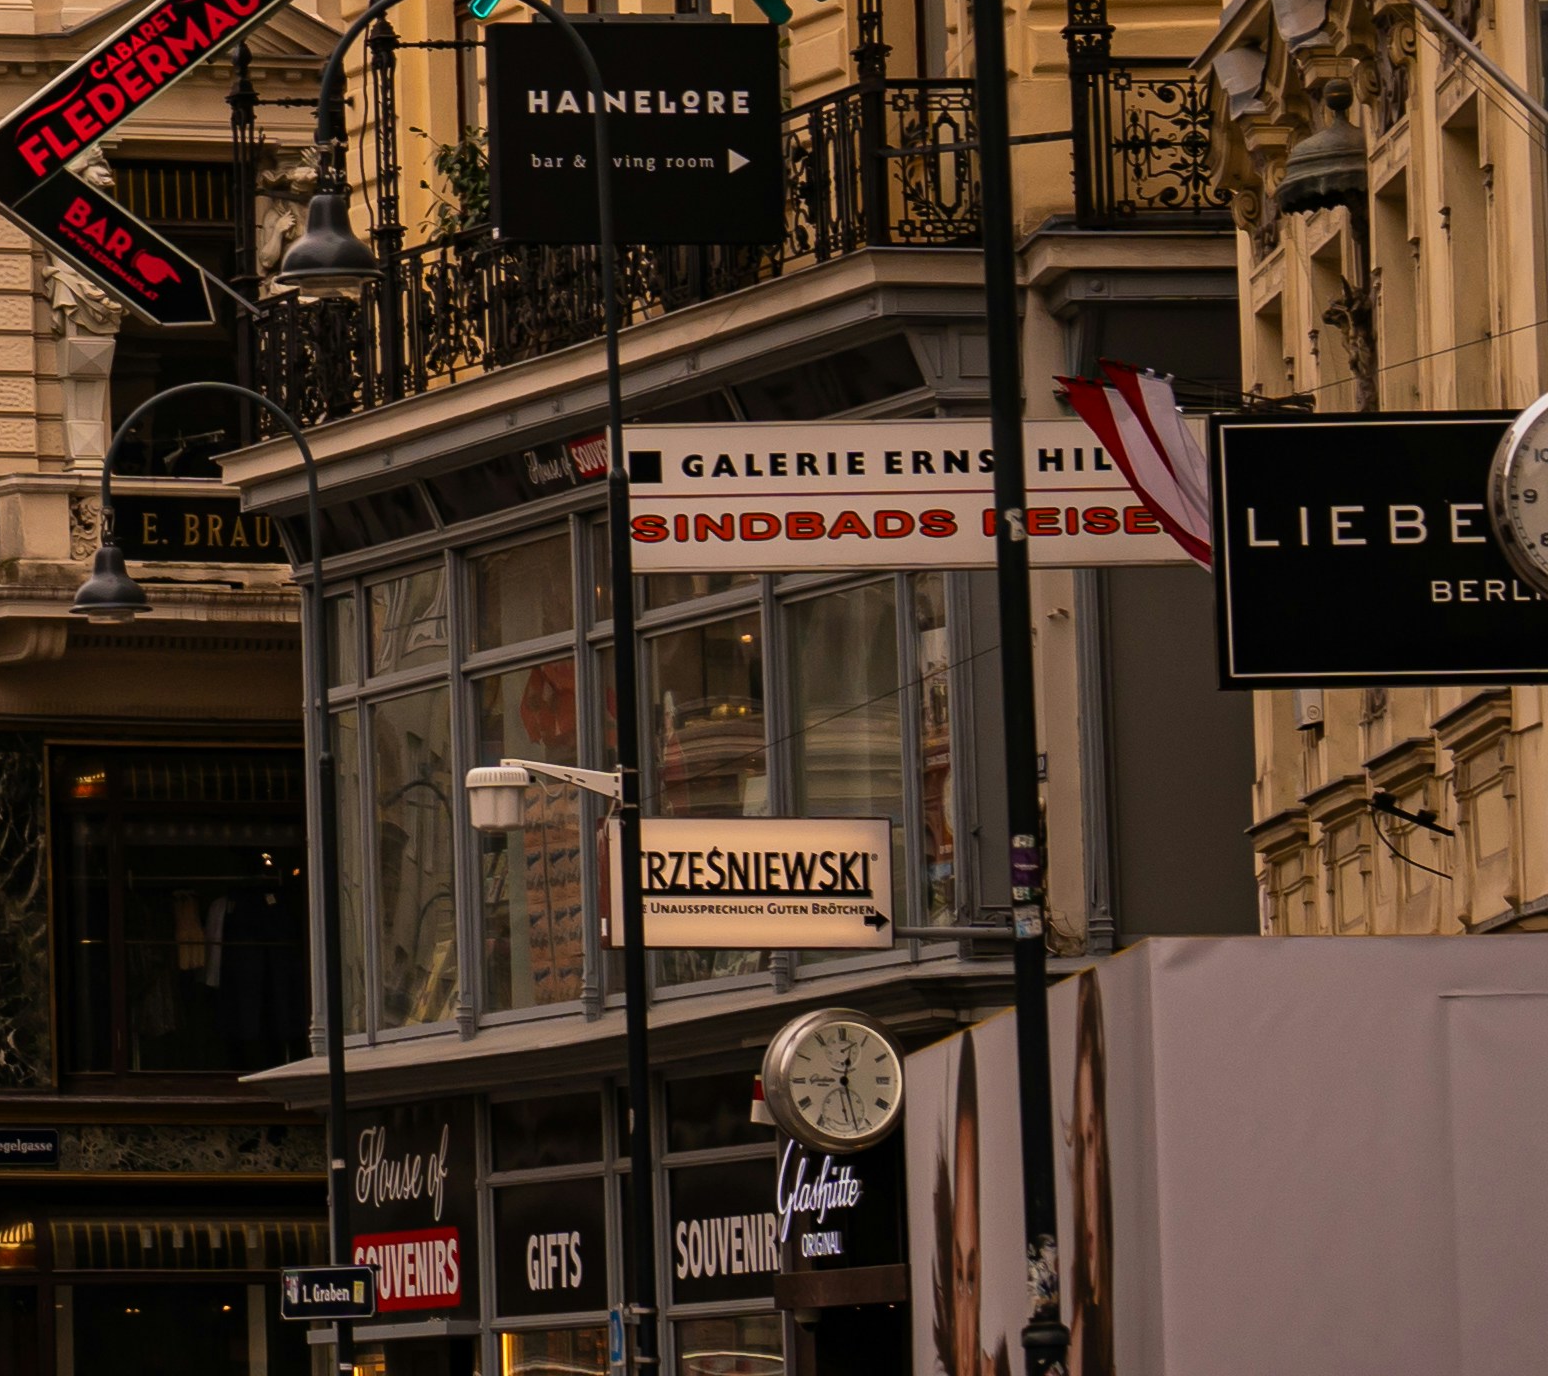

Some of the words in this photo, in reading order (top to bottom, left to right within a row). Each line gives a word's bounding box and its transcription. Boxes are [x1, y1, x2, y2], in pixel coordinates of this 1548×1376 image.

[89, 4, 179, 80] CABARET
[531, 153, 564, 168] bar
[573, 155, 586, 168] &
[612, 154, 656, 172] ving
[666, 156, 715, 168] room
[63, 197, 133, 261] BAR
[681, 451, 866, 478] GALERIE
[884, 449, 996, 475] ERNS
[1038, 447, 1113, 472] HIL
[1523, 488, 1538, 504] 9
[142, 513, 168, 546] E.
[184, 513, 284, 547] BRAU
[631, 508, 958, 543] SINDBADS
[982, 506, 1168, 538] EISE
[1247, 503, 1487, 547] LIEBE
[1431, 579, 1541, 602] BERL
[651, 903, 764, 915] UNAUSSPRECHLICH
[767, 903, 809, 915] GUTEN
[356, 1125, 423, 1208] House
[427, 1123, 448, 1222] of
[527, 1231, 583, 1291] GIFTS
[676, 1212, 782, 1280] SOUVENIR
[801, 1231, 844, 1257] ORIGINAL
[313, 1283, 350, 1303] Graben
